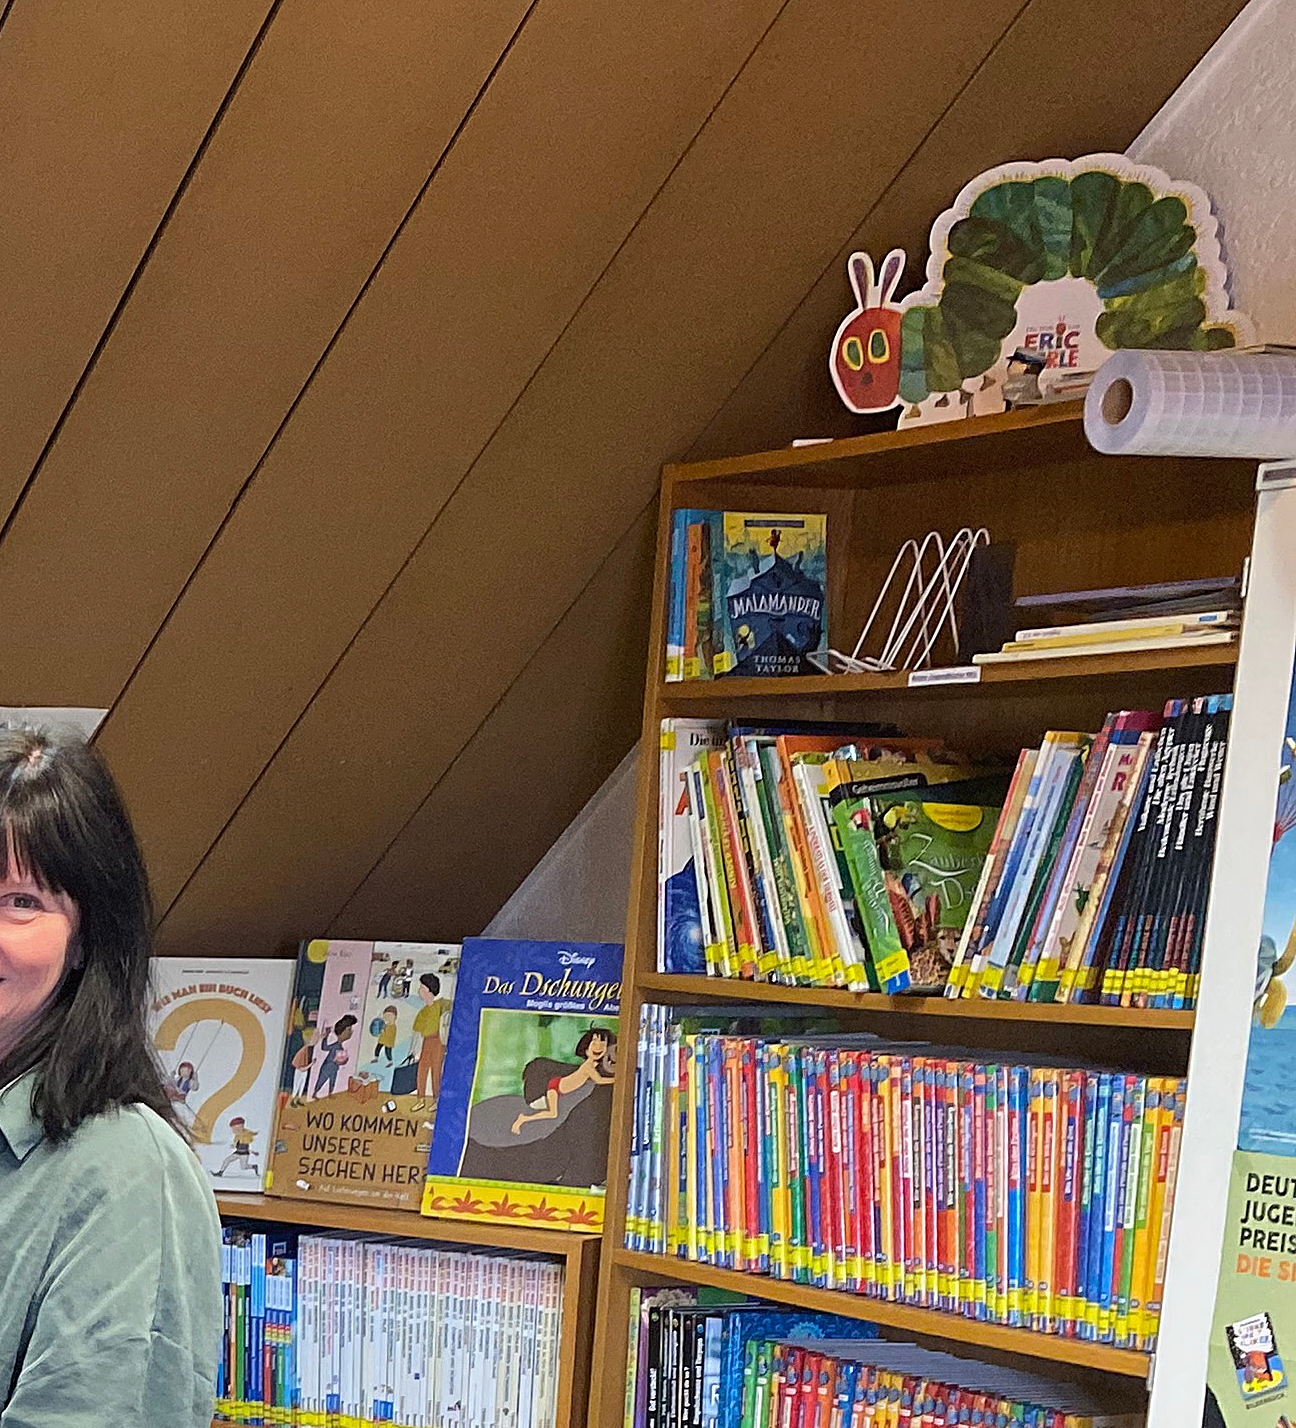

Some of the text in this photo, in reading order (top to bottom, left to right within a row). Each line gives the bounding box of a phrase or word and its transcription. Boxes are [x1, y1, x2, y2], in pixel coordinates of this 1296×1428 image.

[1025, 331, 1080, 349] ERIC
[731, 593, 820, 620] MALAMANDER
[754, 655, 801, 664] THOMAS
[756, 665, 799, 673] TAYLOR
[690, 733, 708, 746] Die
[557, 951, 596, 969] Disney
[171, 984, 197, 1000] MAN
[199, 984, 217, 993] EIN
[218, 984, 249, 999] BUCH
[482, 967, 622, 1010] Das Dschungel
[307, 1110, 419, 1137] WO KOMMEN
[302, 1134, 373, 1157] UNSERE
[298, 1157, 376, 1180] SACHEN
[1246, 1173, 1296, 1198] DEUT
[1240, 1200, 1296, 1226] JUGE
[1236, 1253, 1272, 1278] DIE
